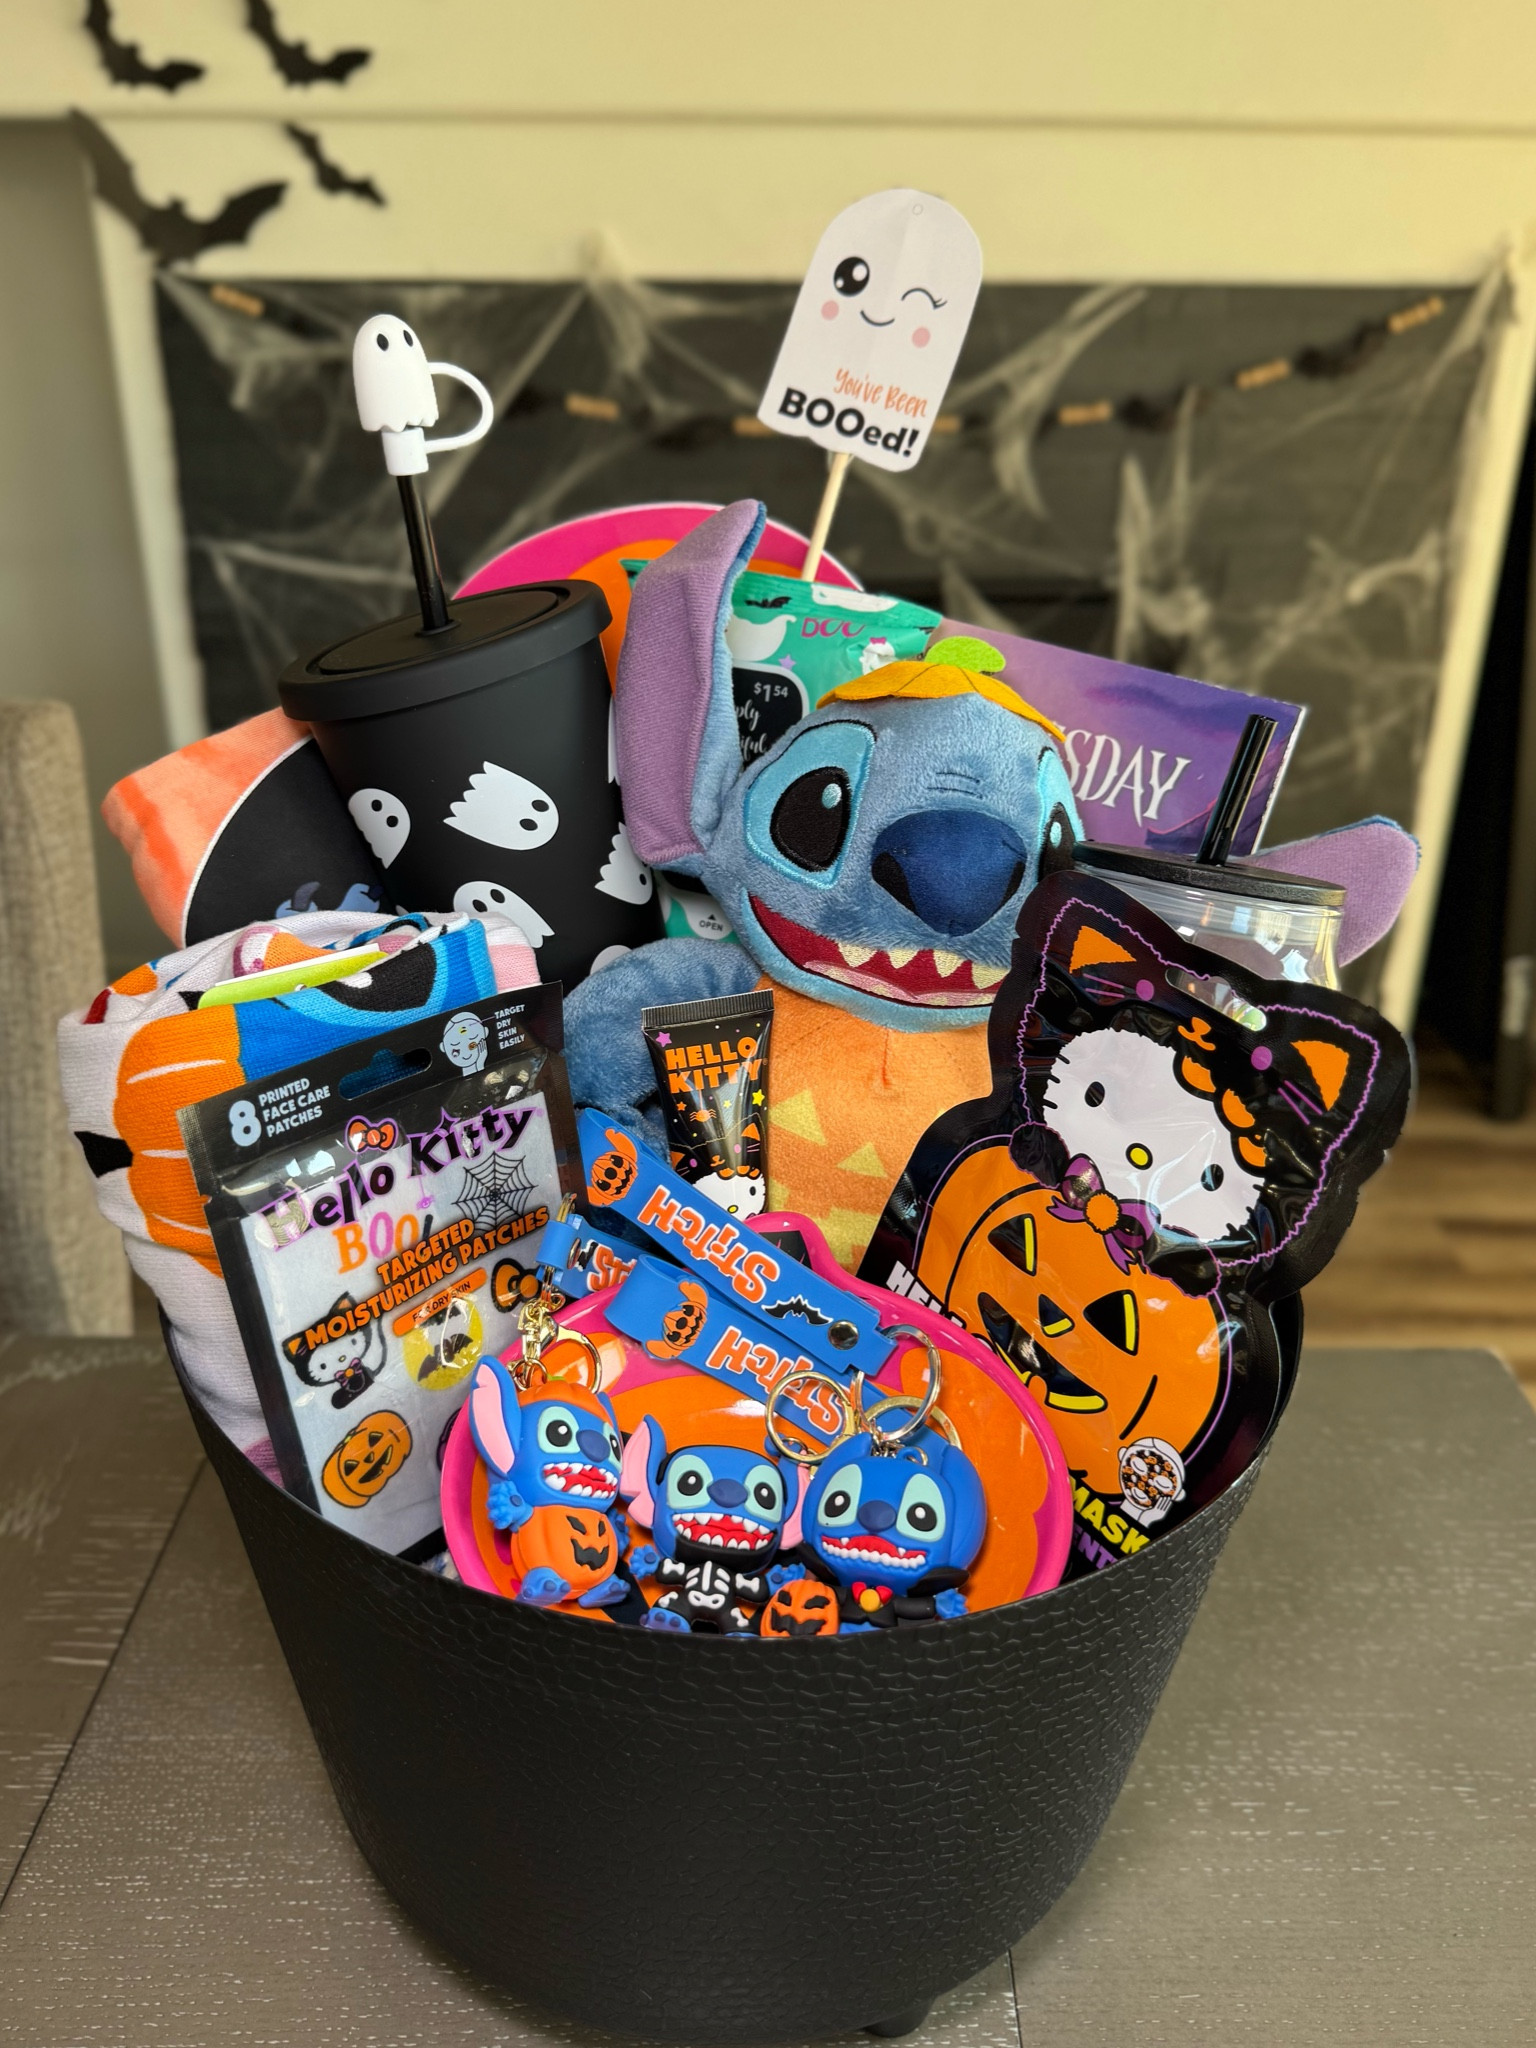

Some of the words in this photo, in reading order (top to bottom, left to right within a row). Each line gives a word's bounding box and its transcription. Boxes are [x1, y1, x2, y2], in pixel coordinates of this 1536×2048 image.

[834, 368, 884, 404] You've
[884, 384, 929, 418] Been
[778, 387, 919, 458] BOOed!
[735, 699, 760, 731] ply
[1052, 721, 1193, 828] SDAY
[699, 920, 724, 932] OPEN
[494, 1004, 526, 1020] TARGET
[496, 1017, 512, 1030] DRY
[498, 1026, 518, 1040] SKIN
[499, 1033, 526, 1050] EASILY
[665, 1036, 758, 1071] HELLO
[258, 1077, 311, 1108] PRINTED
[668, 1058, 763, 1095] KITTY
[262, 1099, 297, 1123] FACE
[297, 1085, 331, 1108] CARE
[266, 1105, 323, 1138] PATCHES
[228, 1100, 262, 1147] 8
[257, 1159, 397, 1251] Hello
[406, 1105, 538, 1178] Kitty
[376, 1218, 476, 1286] TARGETED
[304, 1251, 459, 1351] MOISTURIZING
[458, 1205, 550, 1266] PATCHES
[431, 1293, 450, 1311] DRY
